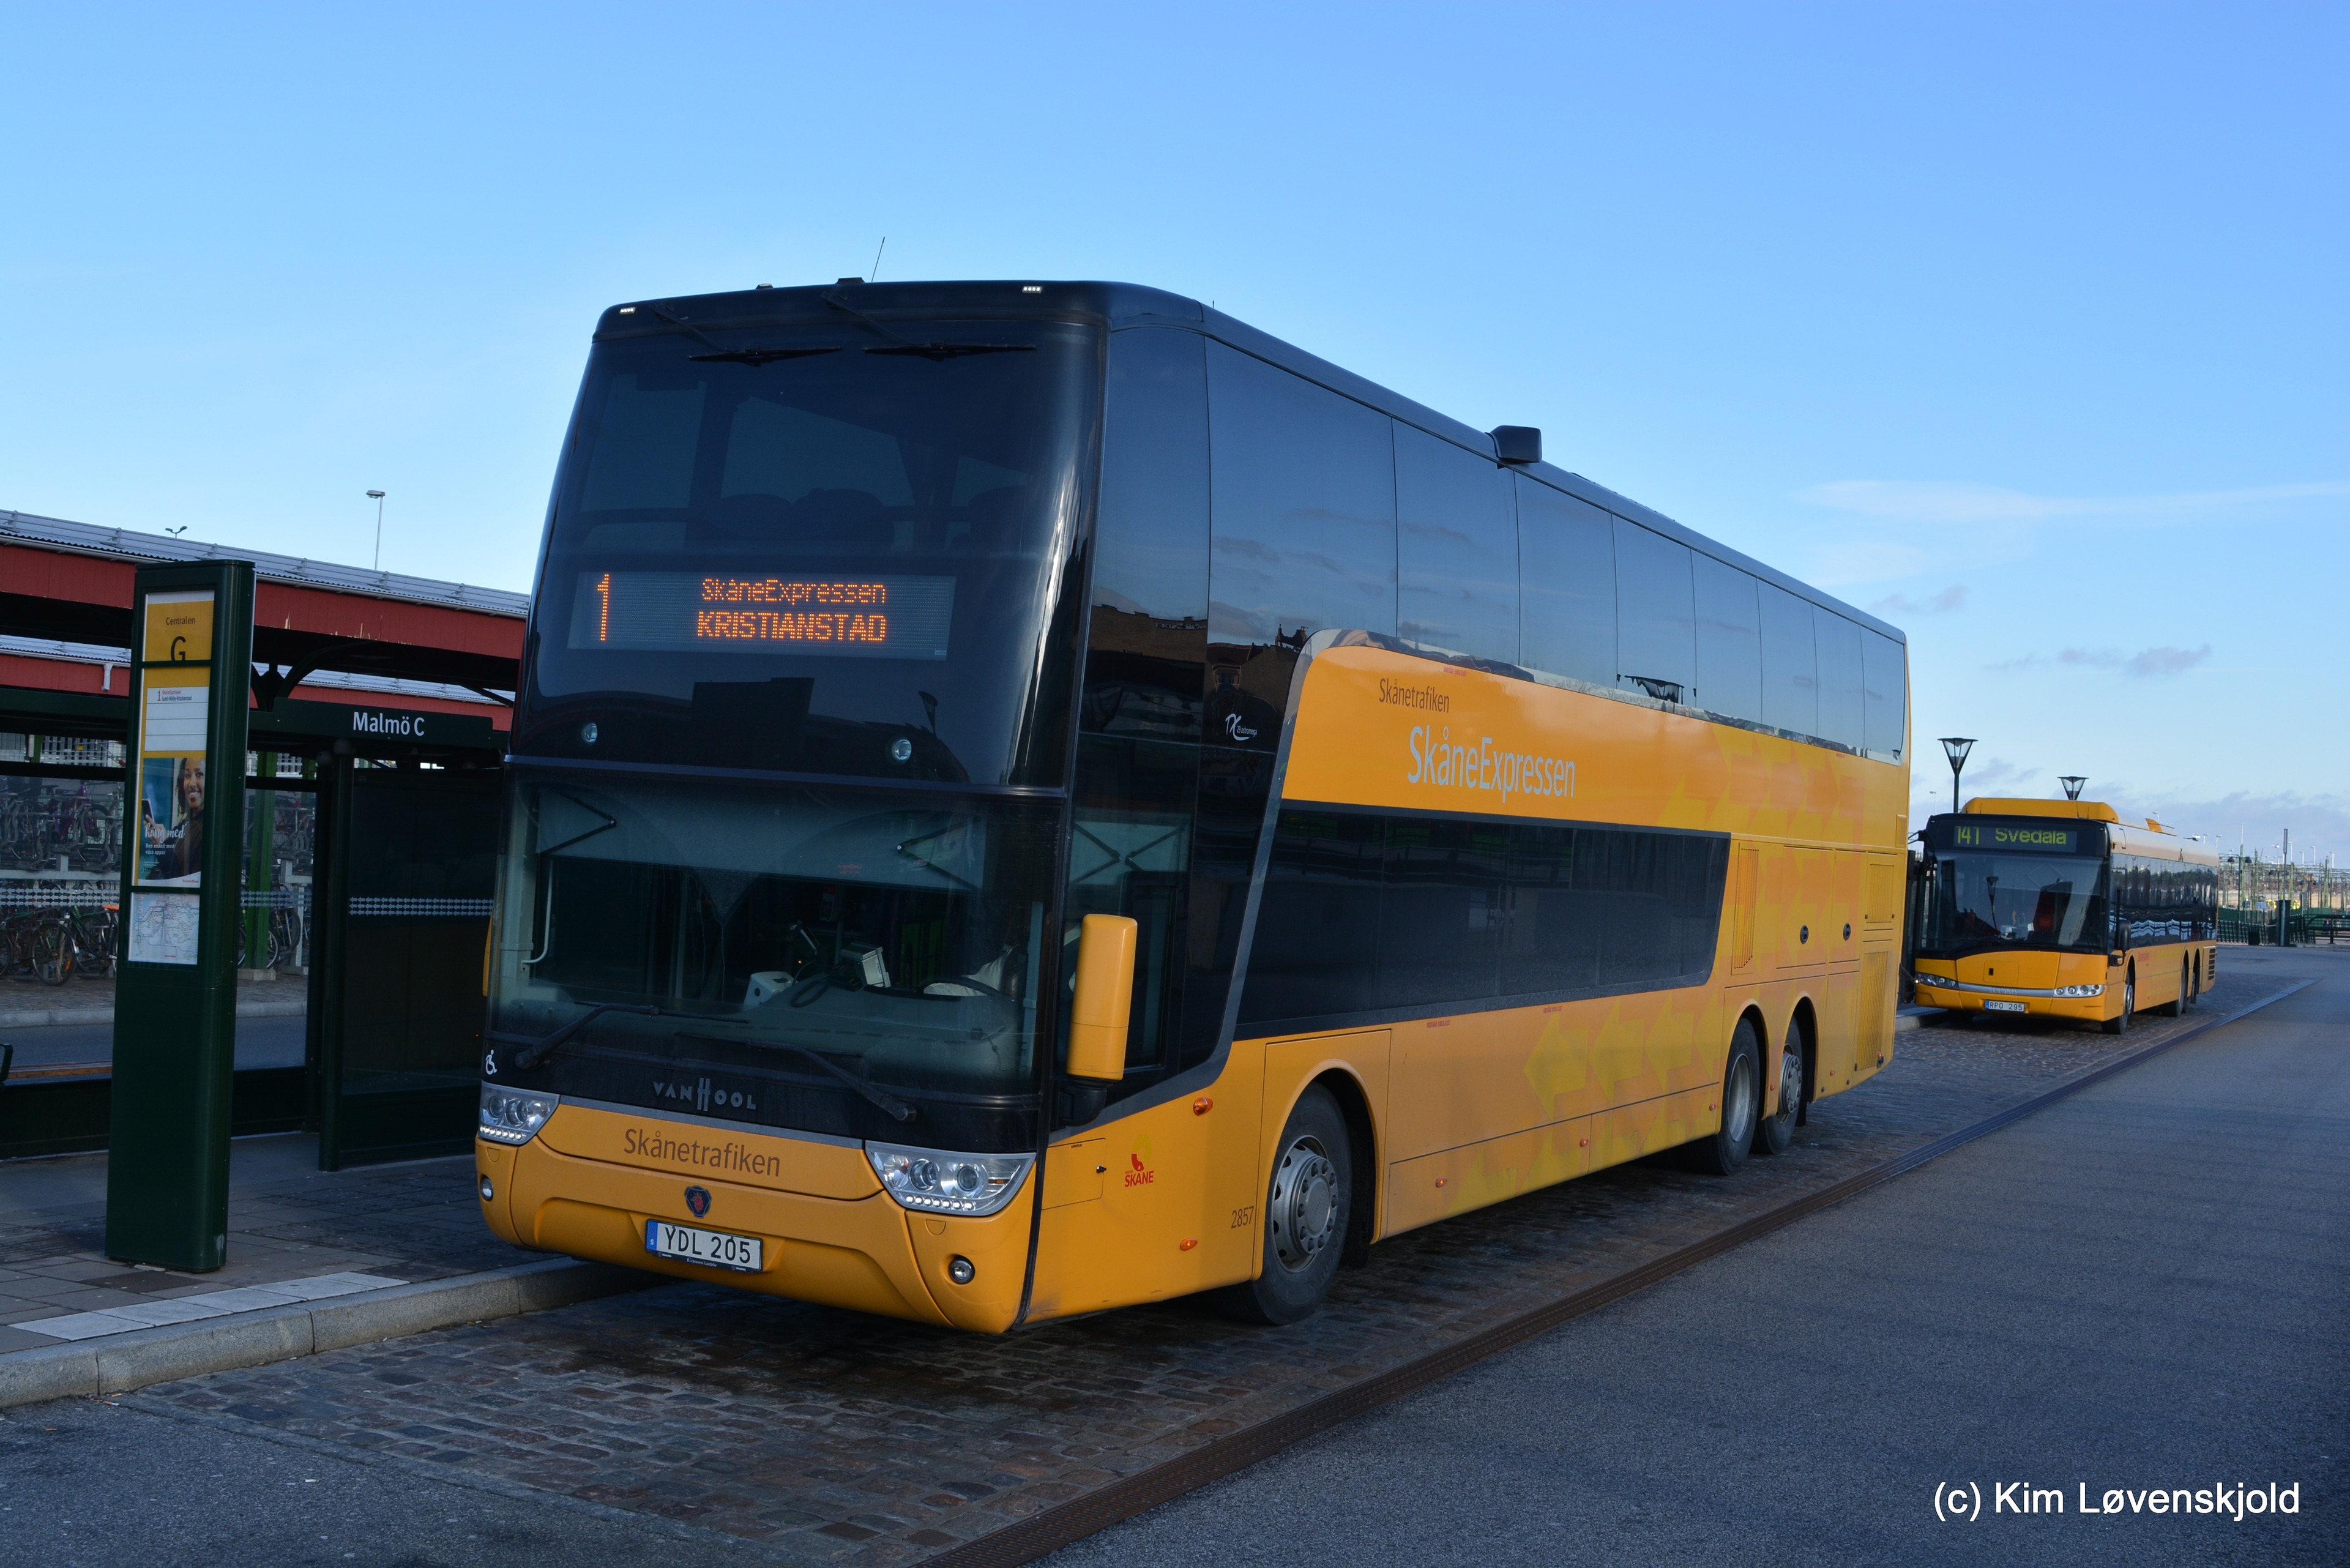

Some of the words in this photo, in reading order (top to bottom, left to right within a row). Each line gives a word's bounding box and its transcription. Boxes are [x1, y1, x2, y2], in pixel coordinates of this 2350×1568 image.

[597, 573, 610, 641] 1
[701, 578, 886, 605] SkåneExpressen
[165, 616, 196, 625] Centralen
[697, 611, 886, 641] KRISTIANSTAD
[170, 636, 187, 661] G
[157, 690, 161, 701] 1
[1379, 678, 1449, 714] Skånetrafiken
[353, 711, 411, 735] Malmö
[414, 717, 425, 736] C
[1408, 725, 1576, 804] SkåneExpressen
[144, 823, 166, 844] häng
[167, 821, 190, 838] med
[1995, 827, 2067, 845] Svedala
[624, 1129, 780, 1177] Skånetrafiken
[1231, 1206, 1254, 1229] 2857
[665, 1226, 702, 1255] YDL
[711, 1236, 751, 1264] 205
